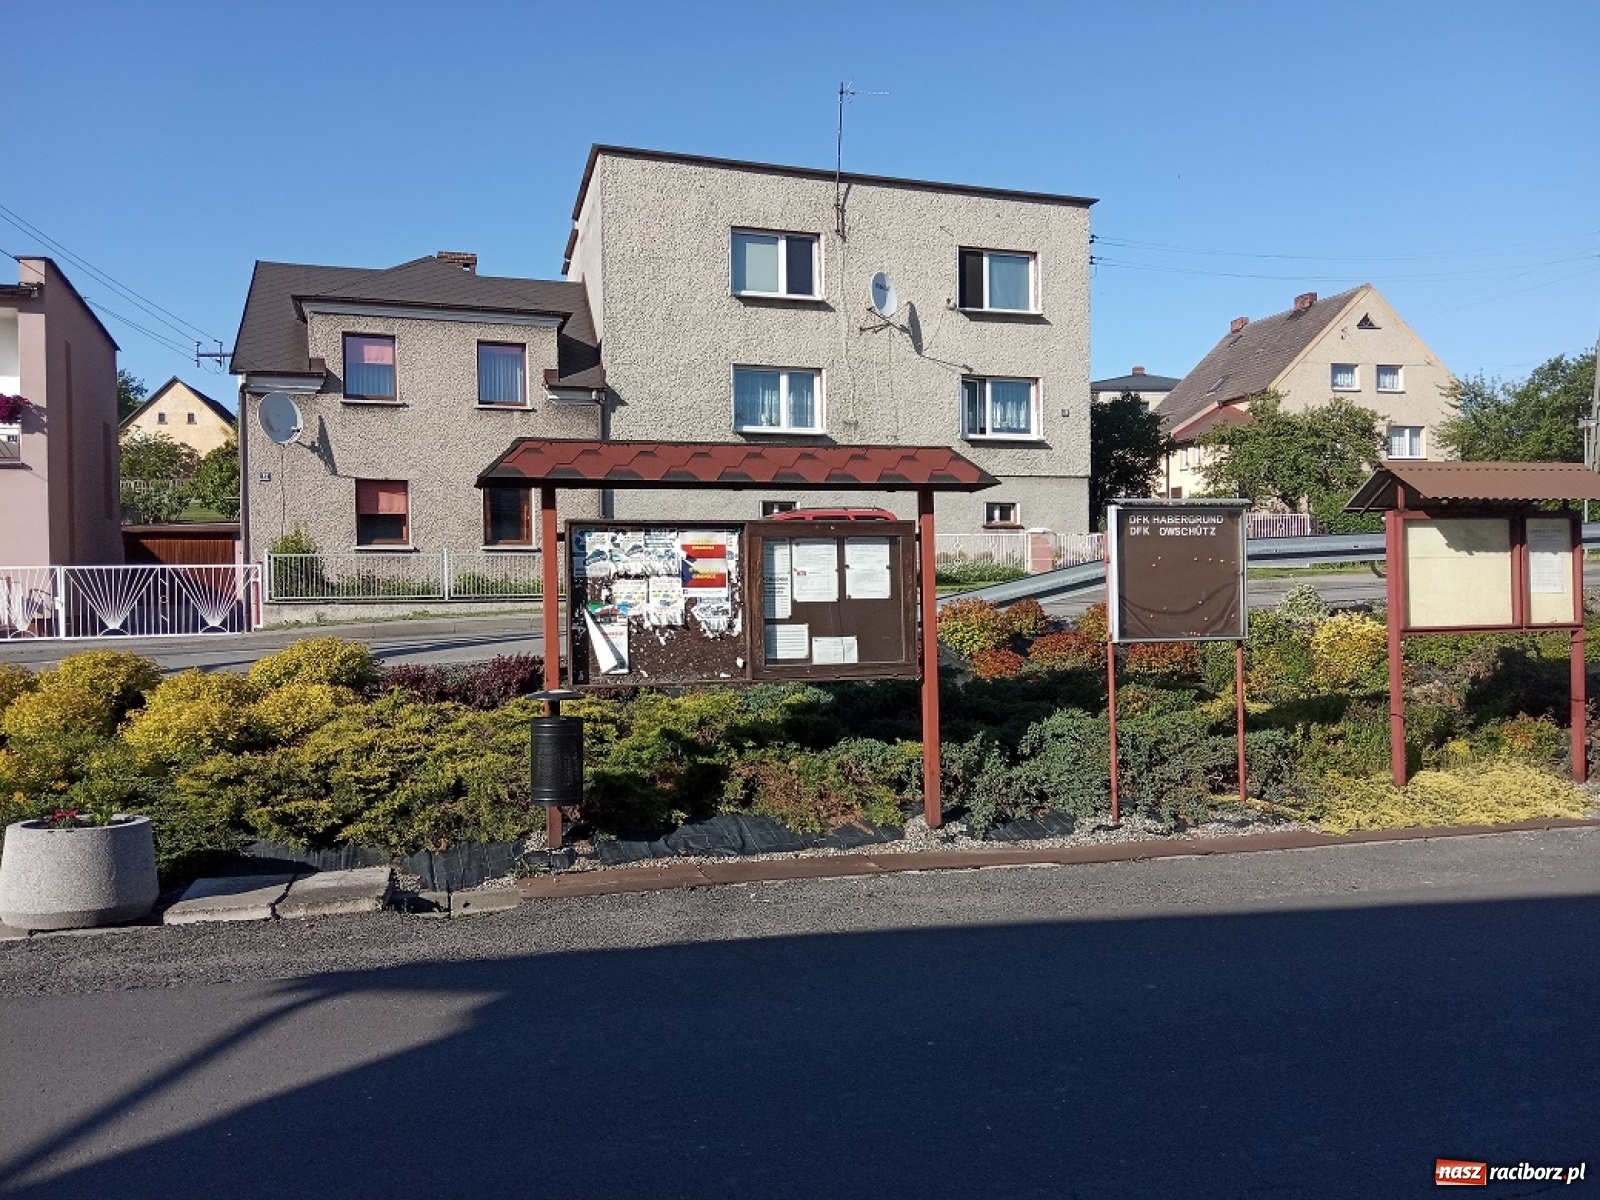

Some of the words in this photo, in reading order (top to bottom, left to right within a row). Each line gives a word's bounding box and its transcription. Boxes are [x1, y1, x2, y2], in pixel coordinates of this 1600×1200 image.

[1128, 515, 1150, 524] DFK
[1153, 515, 1224, 524] HABERGRUND
[1130, 526, 1150, 536] DFK
